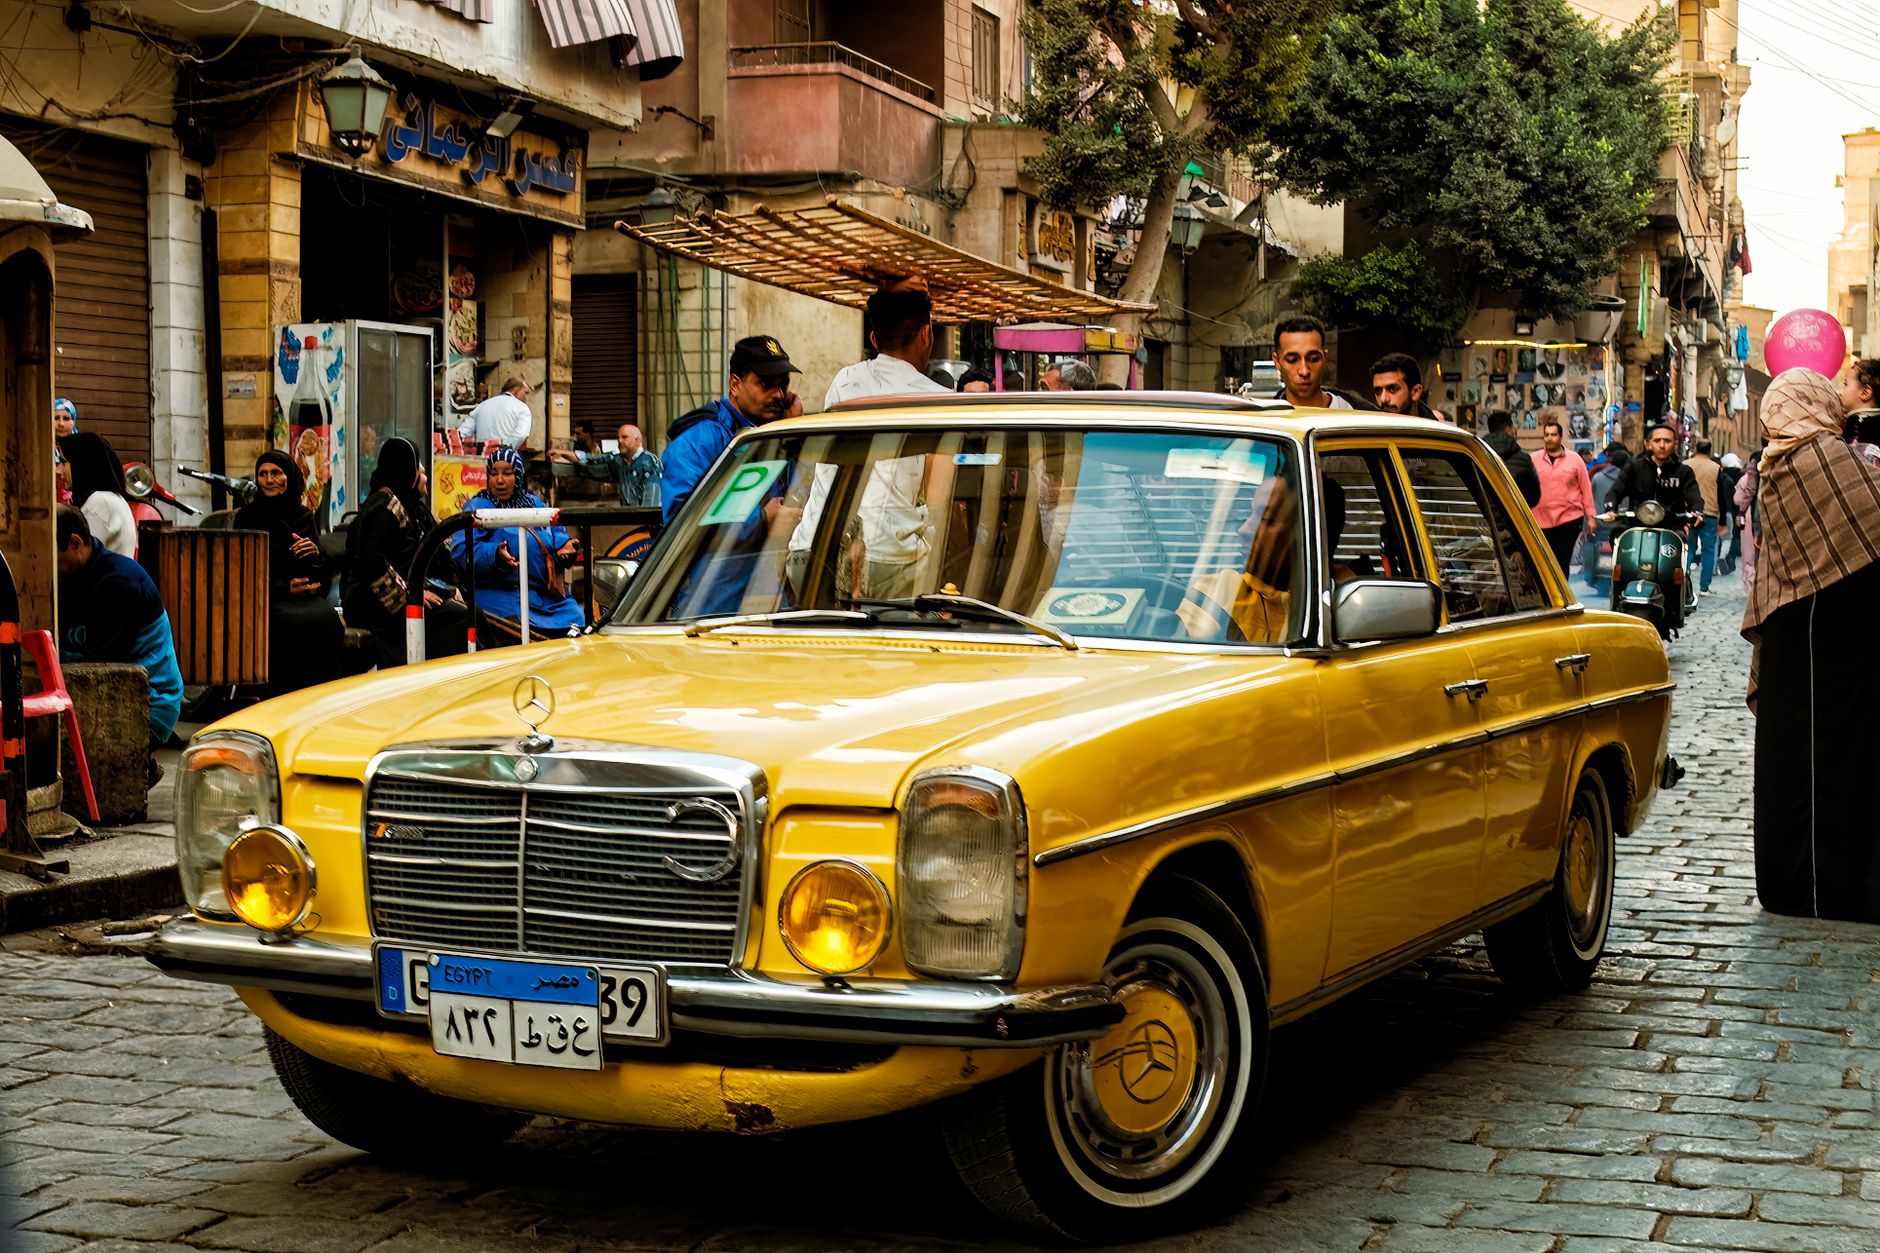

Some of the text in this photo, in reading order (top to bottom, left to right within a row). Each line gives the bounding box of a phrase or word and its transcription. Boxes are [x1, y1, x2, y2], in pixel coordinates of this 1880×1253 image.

[710, 466, 769, 517] P
[444, 964, 494, 986] EGYPT
[530, 974, 580, 991] مصر
